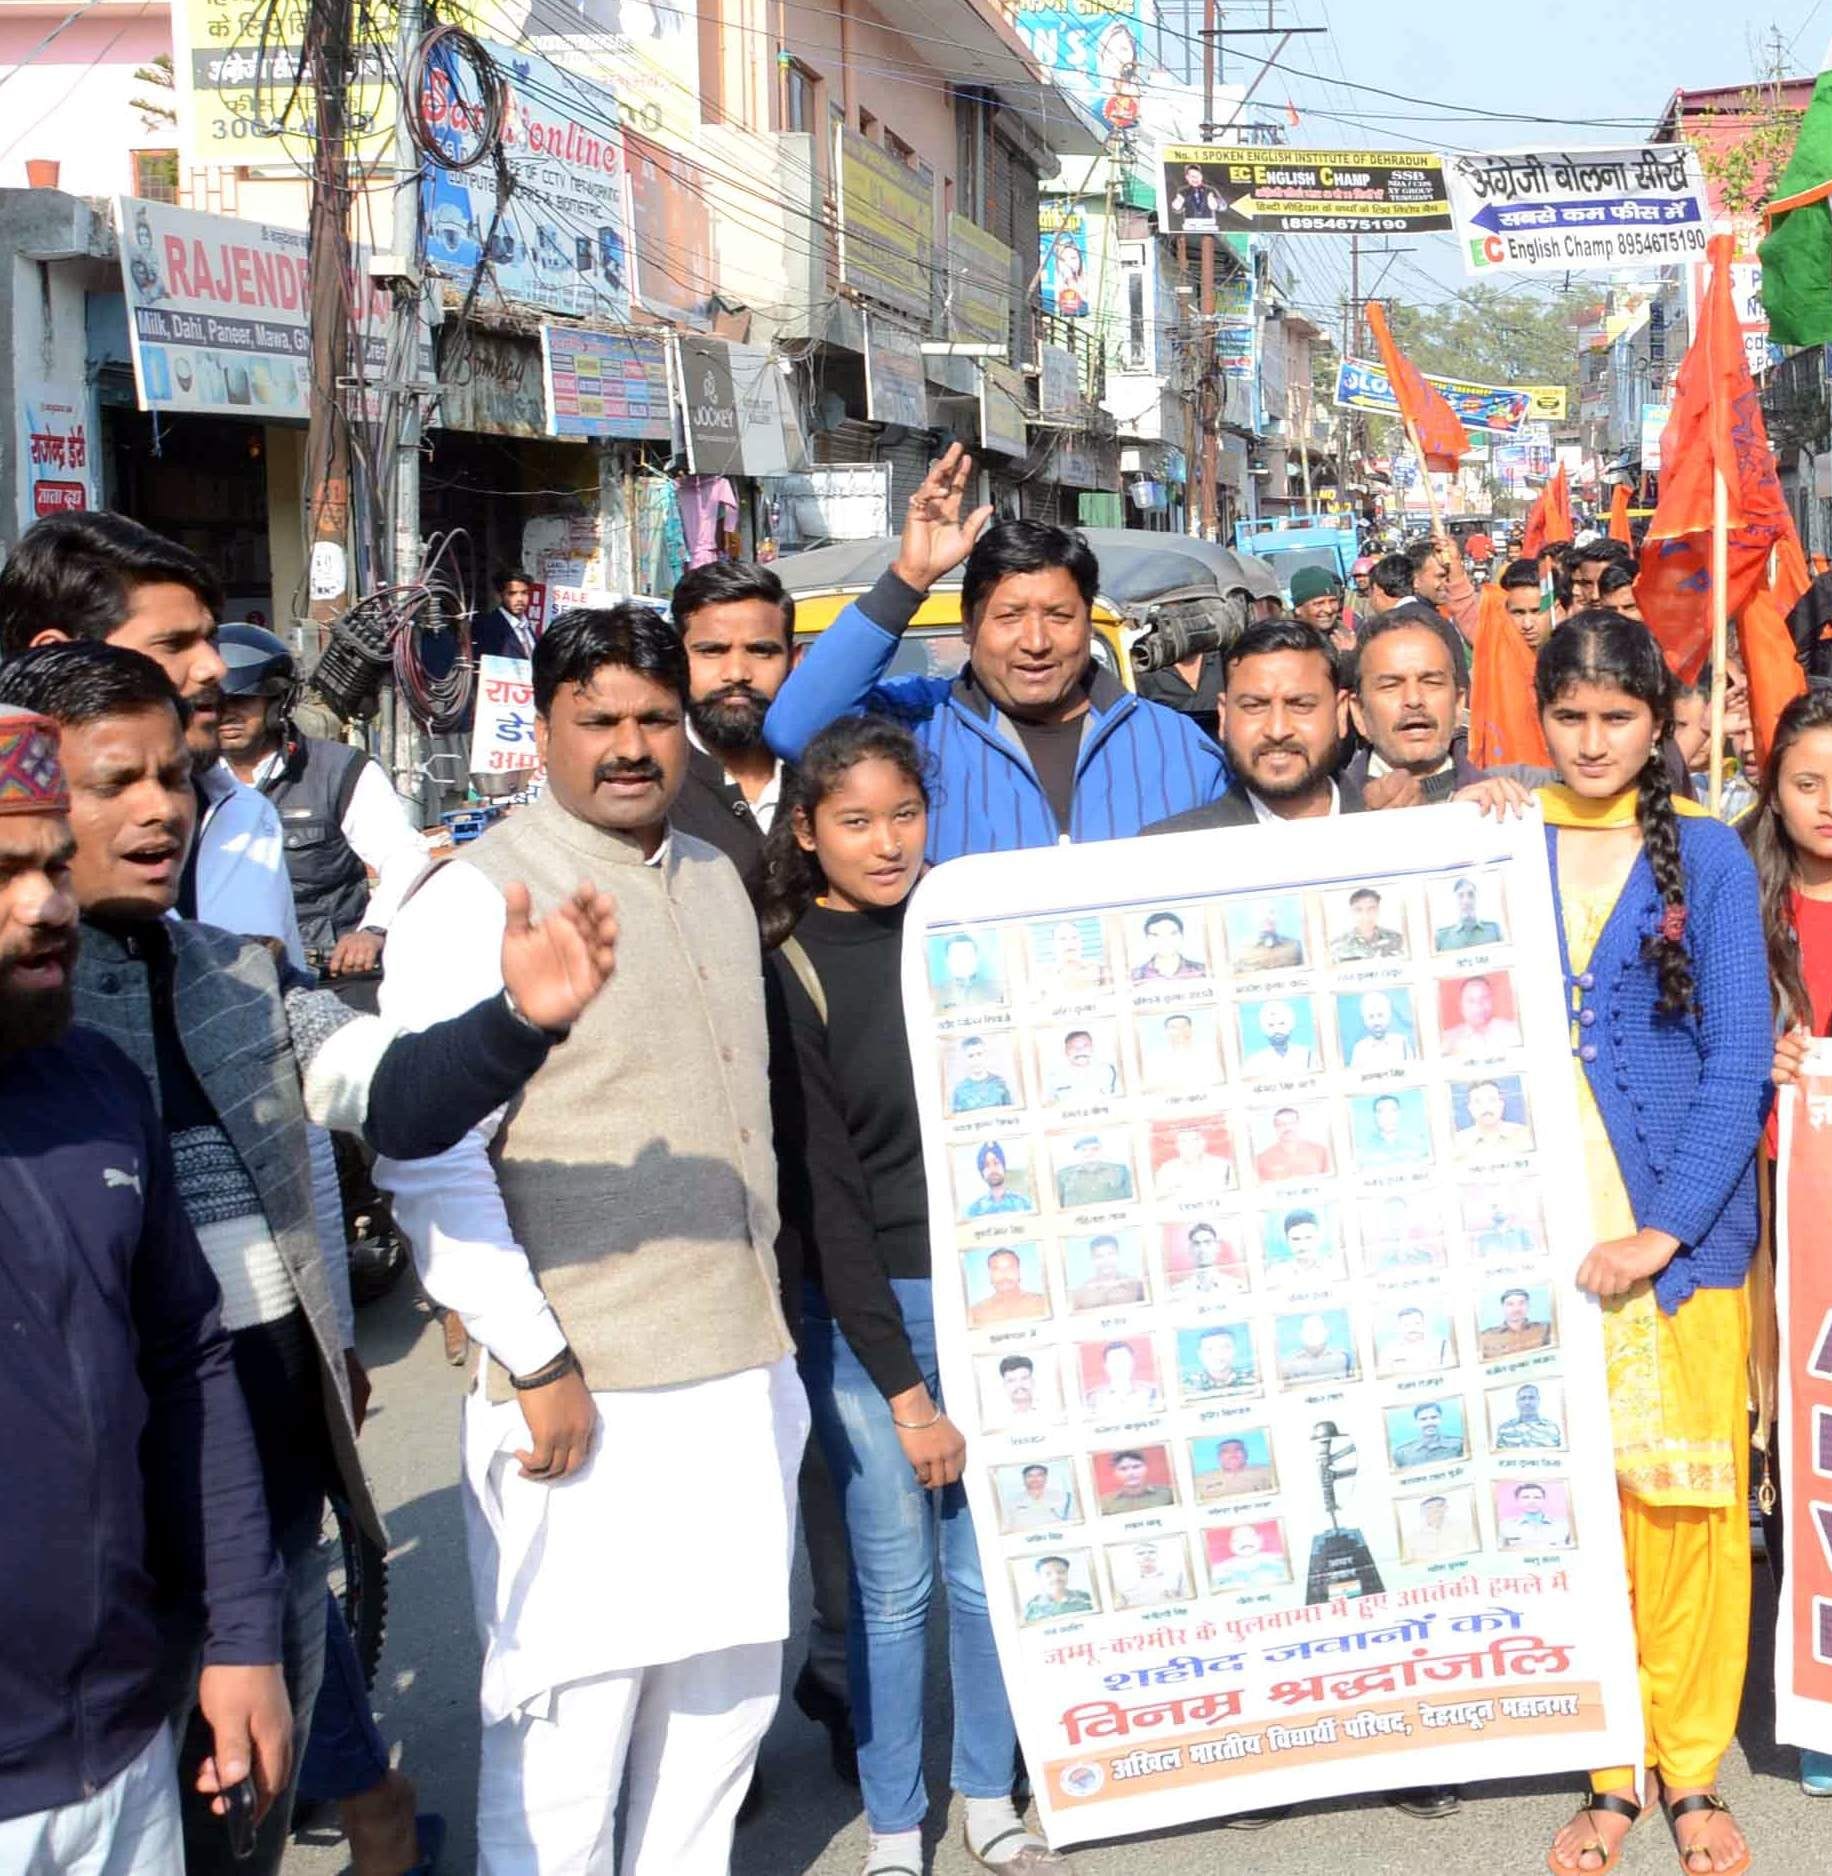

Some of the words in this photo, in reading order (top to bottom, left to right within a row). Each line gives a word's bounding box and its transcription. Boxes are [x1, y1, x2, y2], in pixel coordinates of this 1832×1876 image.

[528, 120, 617, 174] online
[1174, 151, 1191, 161] No.
[1201, 151, 1244, 162] SPOKEN
[1247, 151, 1292, 163] ENGLISH
[1295, 152, 1351, 164] INSTITUTE
[1353, 154, 1366, 165] OF
[1369, 154, 1429, 167] DEHRADUN
[1229, 166, 1251, 183] EC
[1254, 165, 1316, 186] ENGLISH
[1319, 166, 1371, 187] CHAMP
[1390, 170, 1426, 181] SSB
[1473, 153, 1550, 200] अंग्रेजी
[1552, 153, 1629, 194] बोलना
[1631, 149, 1689, 193] सीखें
[1499, 205, 1557, 227] सबसे
[1559, 207, 1606, 223] कम
[1610, 201, 1660, 221] फीस
[1663, 200, 1687, 220] में
[1470, 235, 1506, 267] EC
[1508, 237, 1560, 265] English
[1564, 234, 1614, 260] Champ
[1617, 229, 1706, 256] 8954675190
[163, 233, 311, 321] RAJENDR
[137, 310, 171, 341] Milk,
[172, 314, 206, 348] Dahi,
[208, 320, 255, 351] Paneer,
[255, 325, 293, 354] Mawa,
[693, 406, 735, 429] JOCKEY
[551, 588, 589, 604] SALE
[1197, 1621, 1217, 1642] के
[1226, 1606, 1321, 1643] पुलवामा
[1397, 1574, 1479, 1608] आतंकी
[1488, 1572, 1543, 1599] हमले
[1551, 1569, 1570, 1593] में
[1103, 1652, 1248, 1692] शहीद
[1262, 1612, 1438, 1663] जवानों
[1448, 1606, 1525, 1633] को
[1059, 1688, 1246, 1747] विनम्र
[1267, 1635, 1577, 1706] श्रद्धांजलि
[1110, 1745, 1184, 1782] अखिल
[1188, 1731, 1265, 1766] भारतीय
[1417, 1698, 1497, 1732] देहरादून
[1499, 1692, 1581, 1721] महानगर
